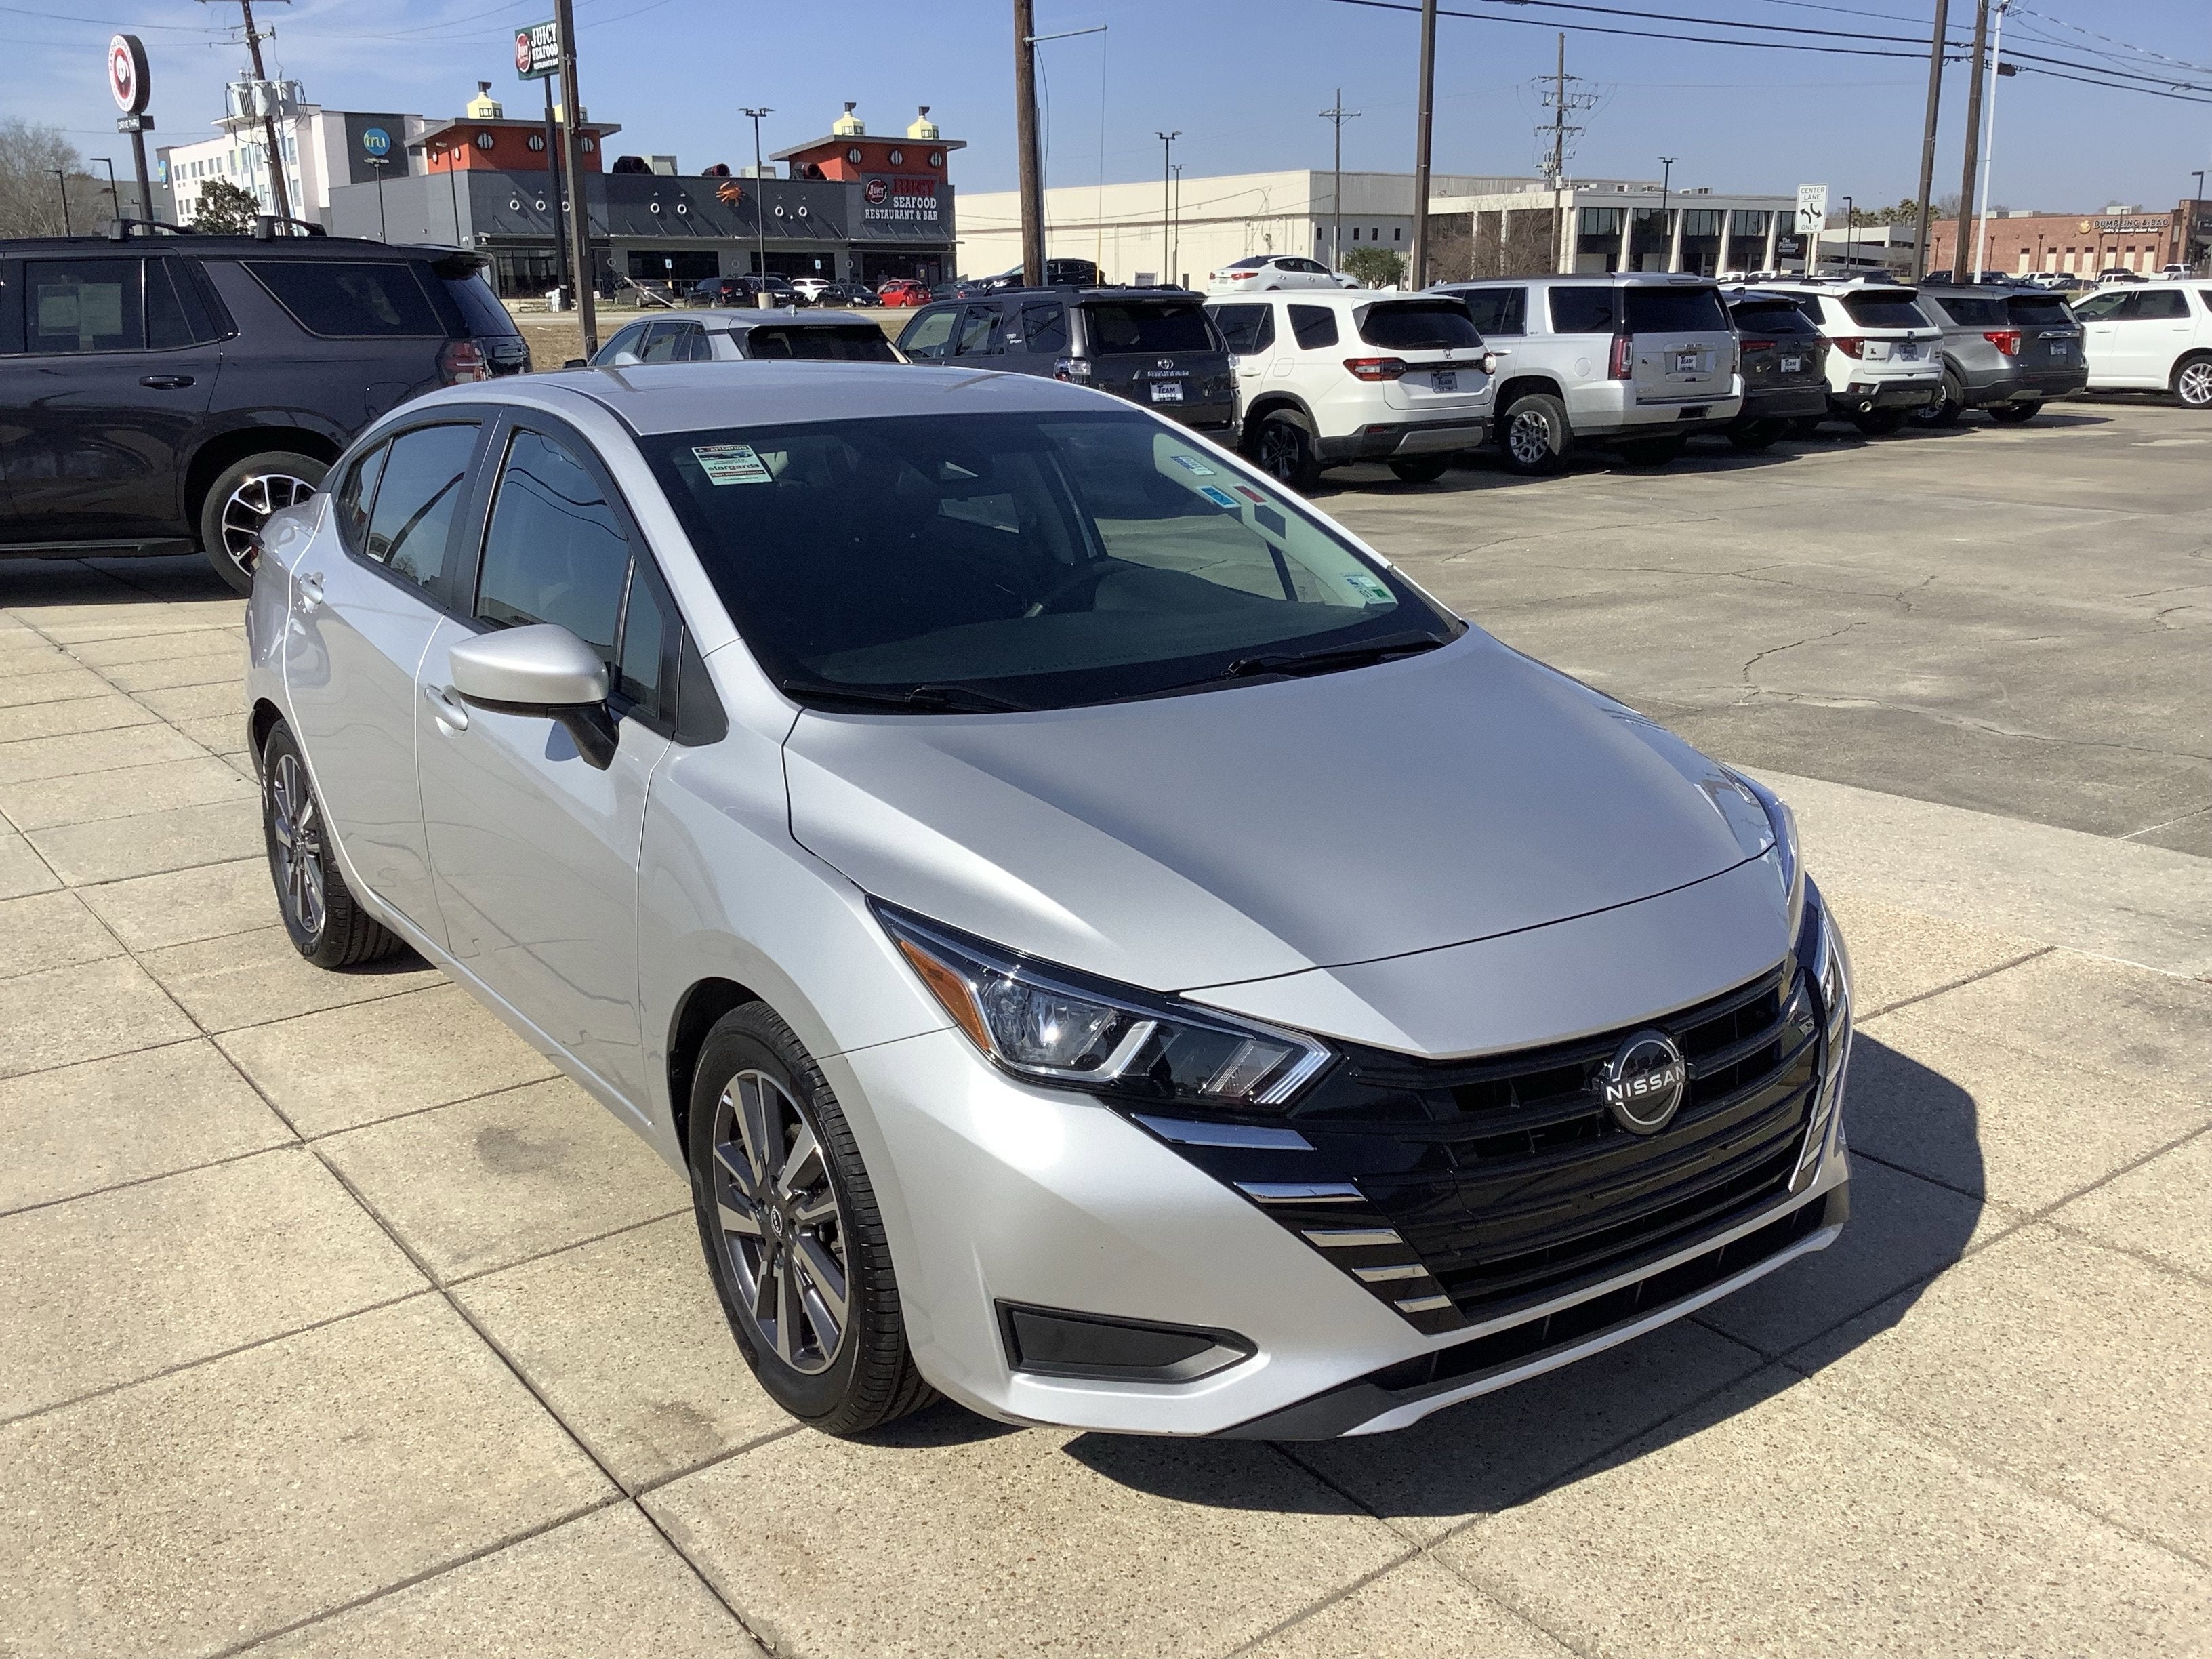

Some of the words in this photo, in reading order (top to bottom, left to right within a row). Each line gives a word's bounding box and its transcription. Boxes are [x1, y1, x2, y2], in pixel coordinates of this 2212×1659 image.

[531, 23, 557, 47] JUICY
[531, 43, 558, 60] SEAFOOD
[366, 134, 386, 148] tru
[893, 196, 937, 209] SEAFOOD
[865, 209, 914, 220] RESTAURANT
[916, 209, 922, 220] &
[923, 210, 938, 220] BAR
[2150, 218, 2169, 228] BAO
[1157, 385, 1176, 394] TEAM
[1606, 1063, 1686, 1101] NISSAN
